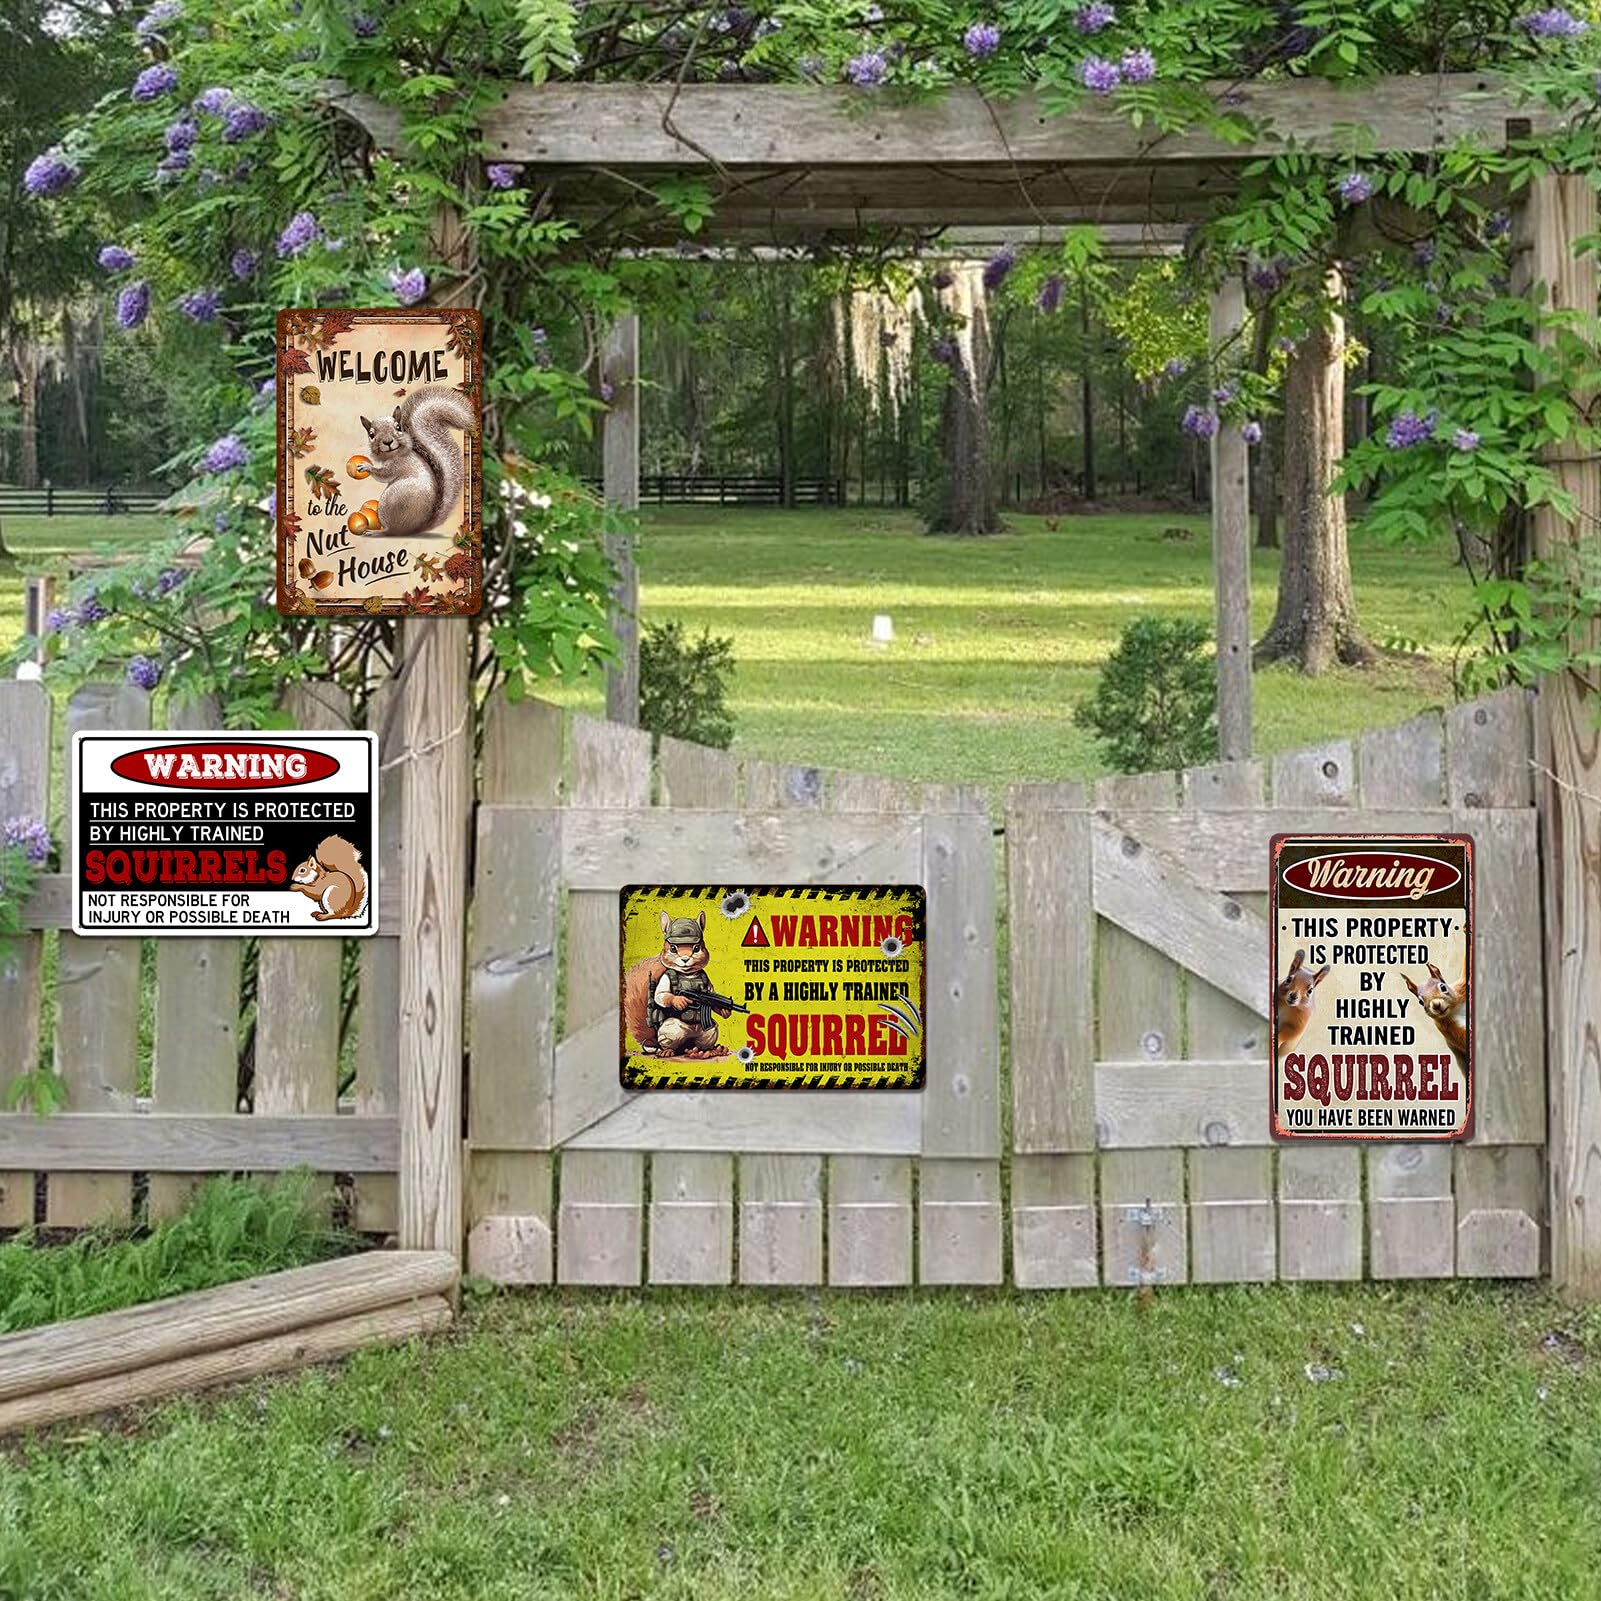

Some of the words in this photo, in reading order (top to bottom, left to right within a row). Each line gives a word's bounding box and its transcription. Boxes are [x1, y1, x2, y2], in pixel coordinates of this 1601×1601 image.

[317, 350, 448, 384] WELCOME
[308, 499, 322, 516] to
[325, 496, 347, 516] the
[307, 525, 350, 558] Nut
[338, 549, 409, 586] House
[144, 754, 307, 779] WARNING
[90, 802, 129, 817] THIS
[135, 802, 226, 817] PROPERTY
[233, 802, 249, 817] IS
[255, 802, 355, 817] PROTECTED
[90, 826, 114, 841] BY
[120, 826, 184, 841] HIGHLY
[190, 826, 264, 841] TRAINED
[85, 850, 287, 885] SQUIRRELS
[1308, 859, 1435, 900] Warning
[88, 894, 116, 907] NOT
[121, 894, 217, 907] RESPONSIBLE
[222, 894, 249, 907] FOR
[89, 911, 142, 923] INJURY
[146, 911, 164, 923] OR
[170, 911, 237, 923] POSSIBLE
[243, 911, 289, 923] DEATH
[771, 915, 912, 947] WARNING
[1291, 918, 1338, 937] THIS
[1347, 918, 1452, 937] PROPERTY
[1310, 945, 1327, 964] IS
[1333, 945, 1428, 964] PROTECTED
[744, 960, 770, 972] THIS
[774, 960, 829, 972] PROPERTY
[832, 960, 843, 972] IS
[847, 960, 909, 972] PROTECTED
[745, 982, 766, 1000] BY
[768, 982, 778, 1000] A
[784, 982, 838, 1000] HIGHLY
[843, 982, 908, 1000] TRAINED
[1361, 972, 1385, 991] BY
[1337, 999, 1409, 1018] HIGHLY
[746, 1014, 907, 1060] SQUIRREL
[1328, 1026, 1415, 1045] TRAINED
[745, 1062, 758, 1072] NOT
[760, 1062, 804, 1072] RESPONSIBLE
[806, 1062, 818, 1072] FOR
[820, 1062, 842, 1072] INJURY
[844, 1062, 852, 1072] OR
[854, 1062, 885, 1072] POSSIBLE
[887, 1062, 908, 1072] DEATH
[1284, 1054, 1458, 1106] SQUIRREL
[1287, 1109, 1313, 1126] YOU
[1319, 1109, 1352, 1126] HAVE
[1359, 1109, 1393, 1126] BEEN
[1398, 1109, 1455, 1126] WARNED
